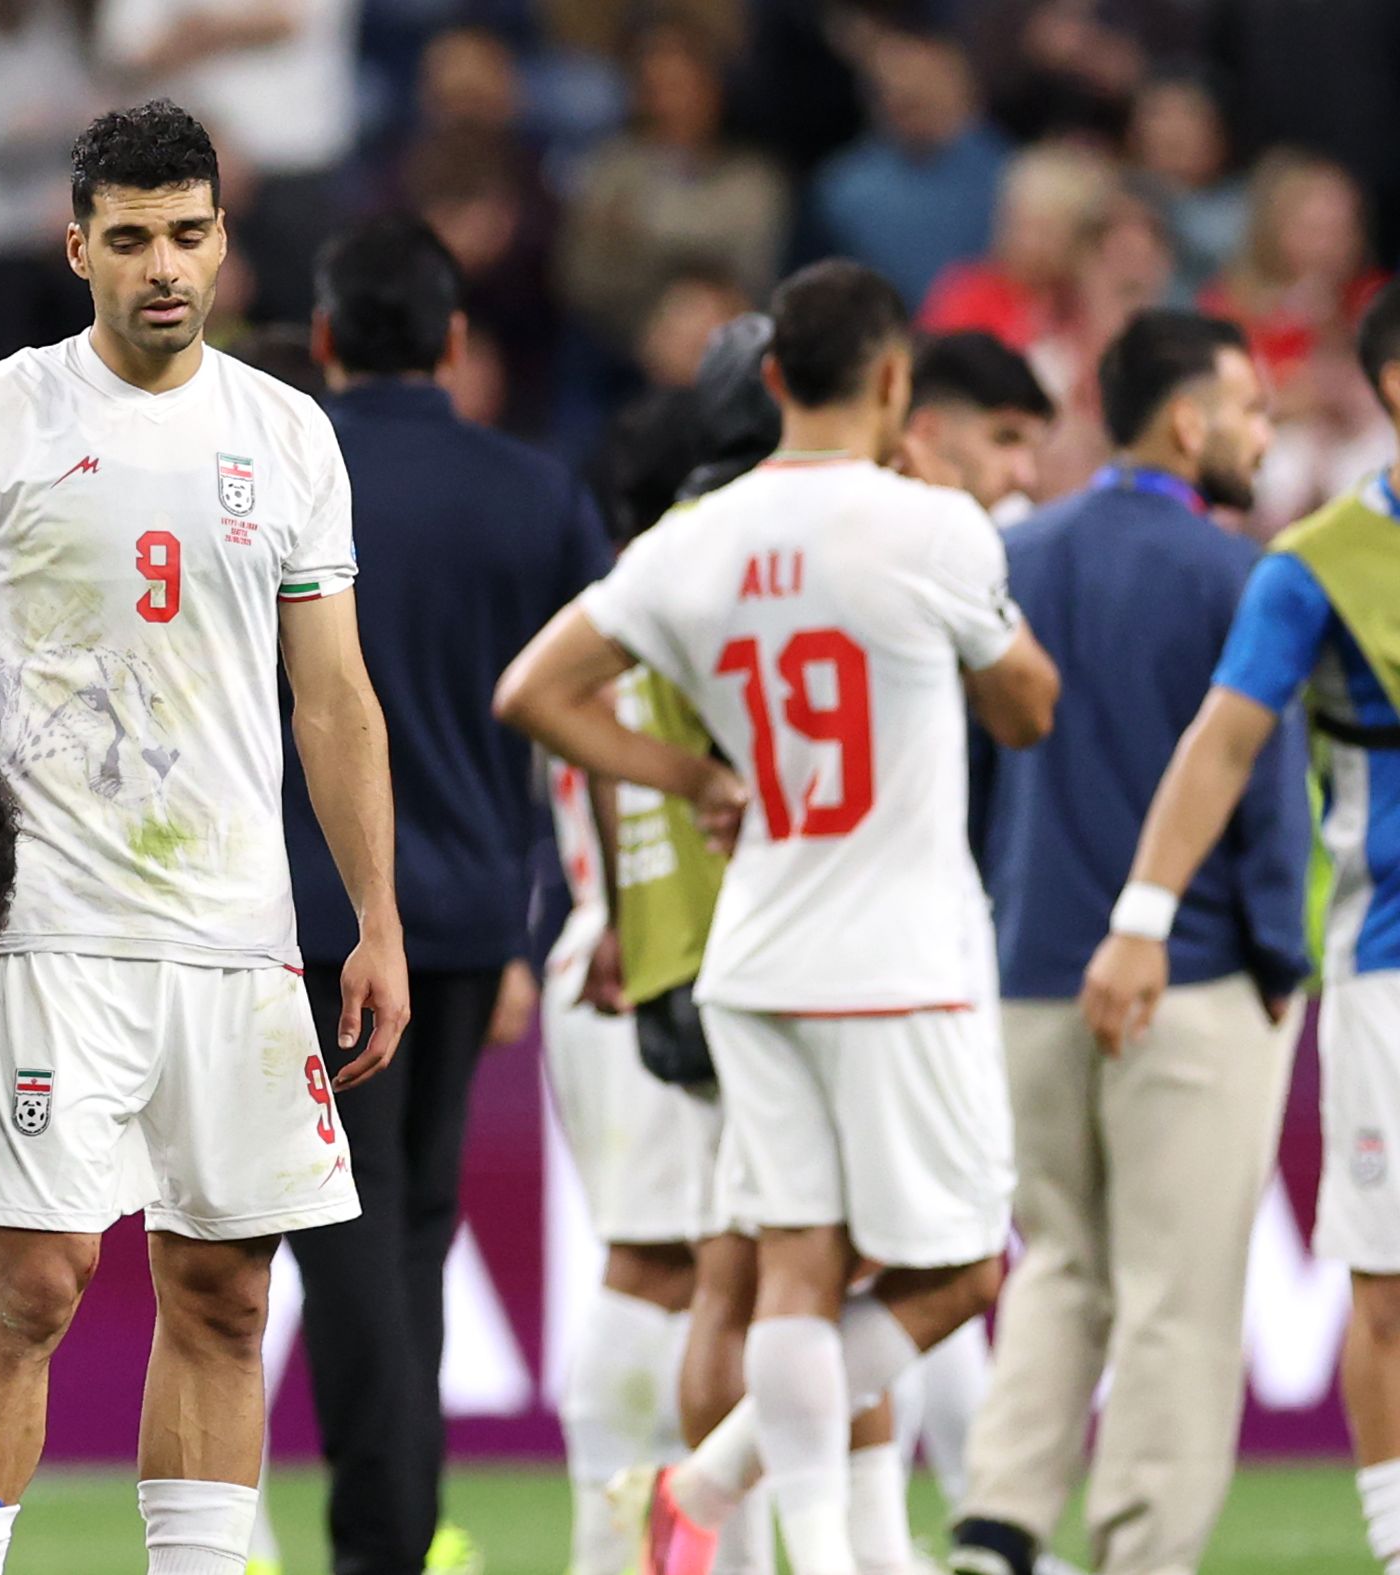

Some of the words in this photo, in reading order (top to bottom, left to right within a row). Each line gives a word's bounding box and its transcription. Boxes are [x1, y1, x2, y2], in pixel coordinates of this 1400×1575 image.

[135, 530, 181, 623] 9
[738, 548, 804, 602] ALI
[712, 627, 875, 842] 19
[304, 1054, 335, 1144] 9
